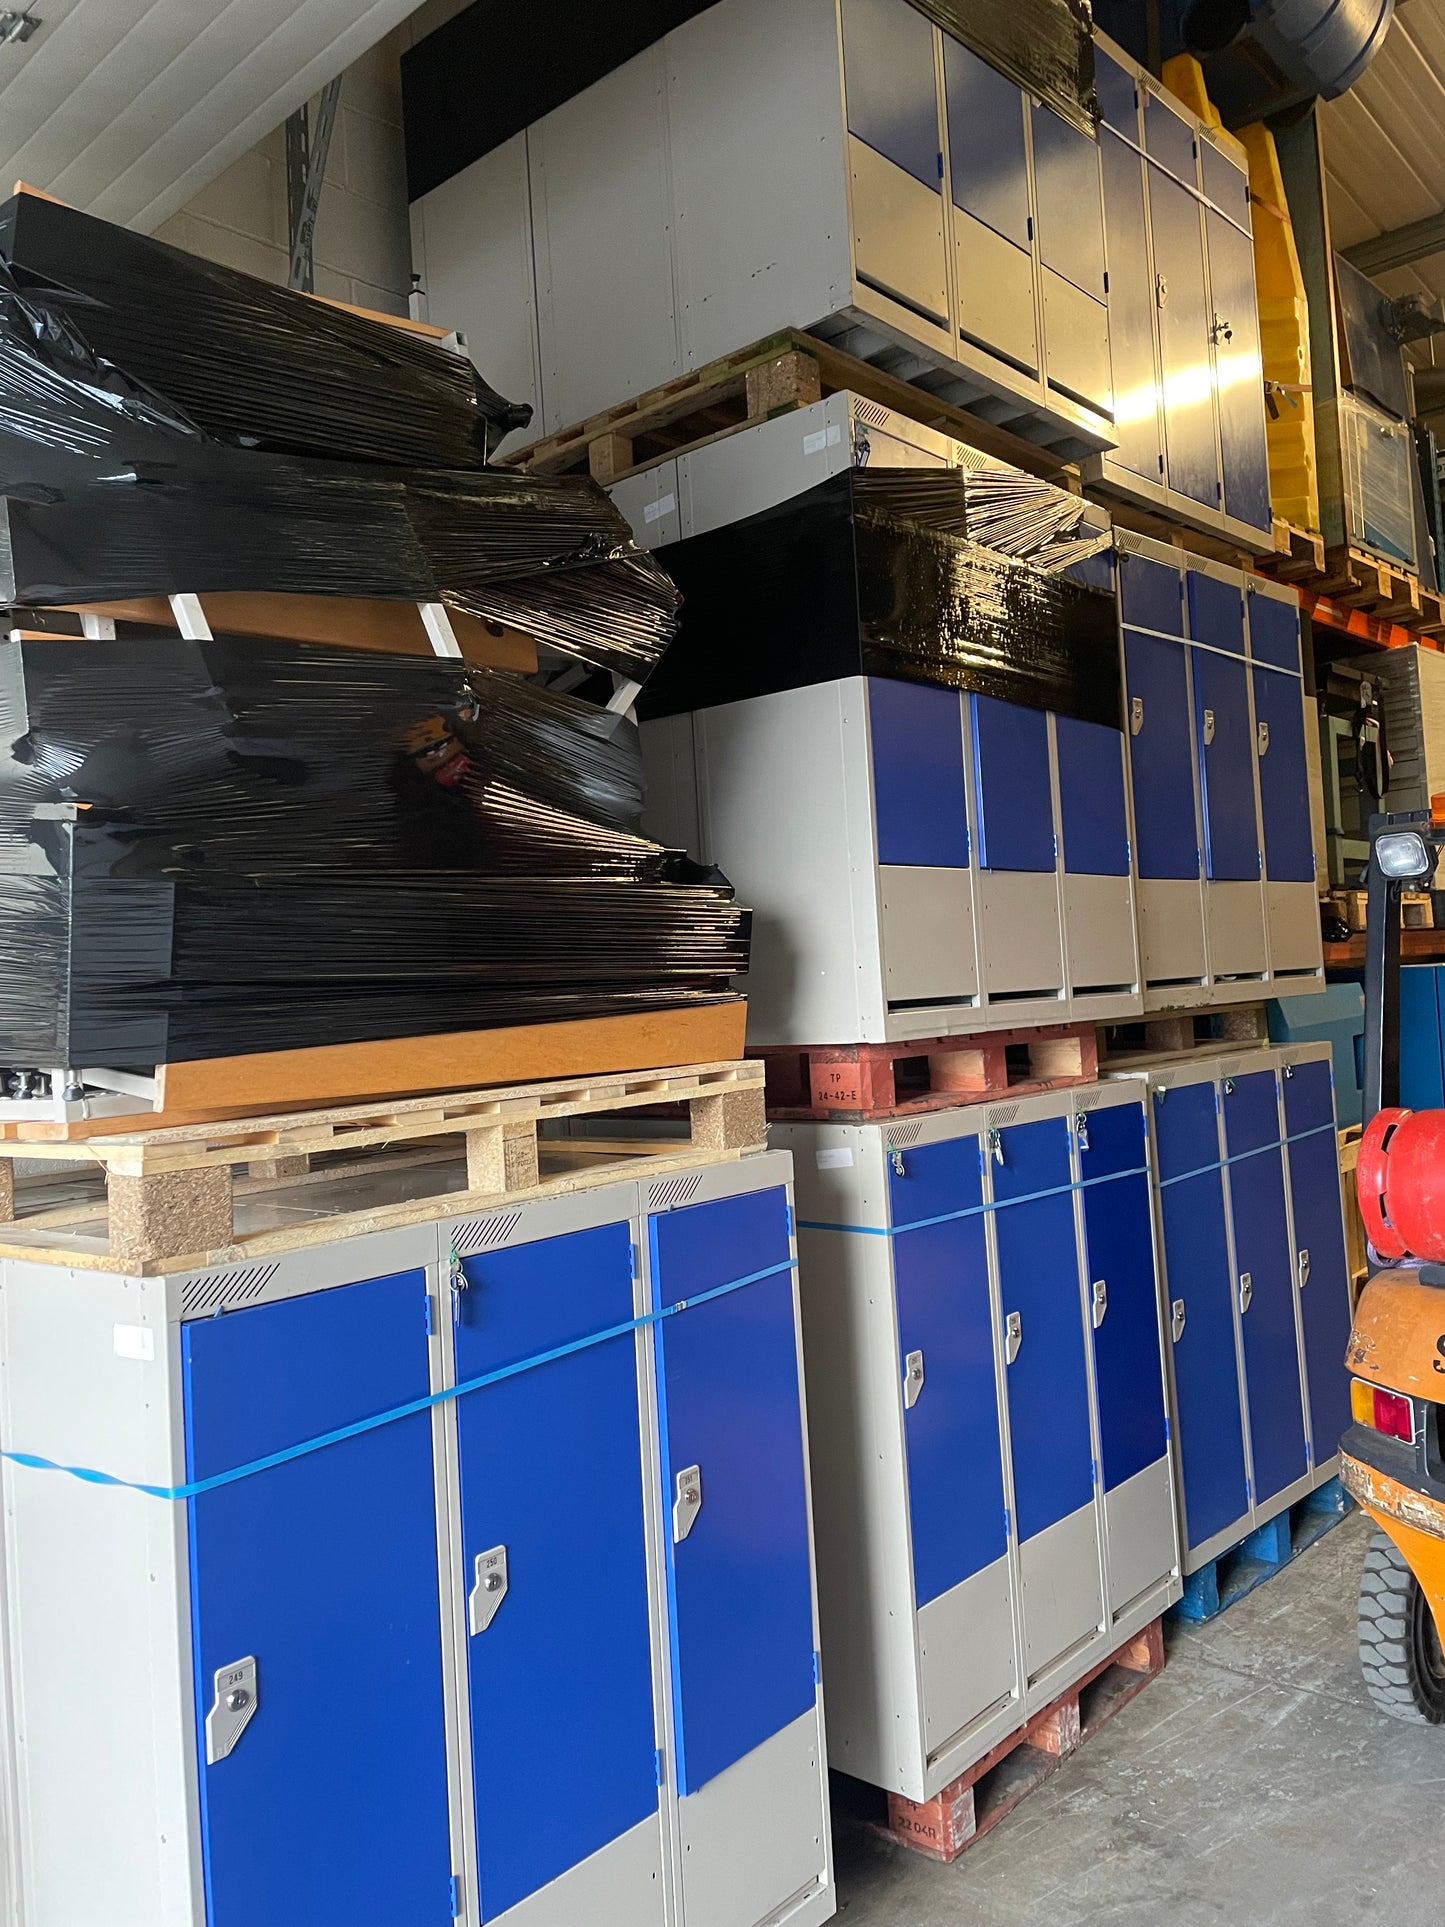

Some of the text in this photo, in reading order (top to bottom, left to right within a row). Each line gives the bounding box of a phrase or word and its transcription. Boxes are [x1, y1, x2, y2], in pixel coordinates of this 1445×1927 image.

[830, 1073, 841, 1083] TP
[818, 1090, 857, 1101] 24-42-E
[486, 1556, 498, 1569] 250
[229, 1670, 243, 1685] 249
